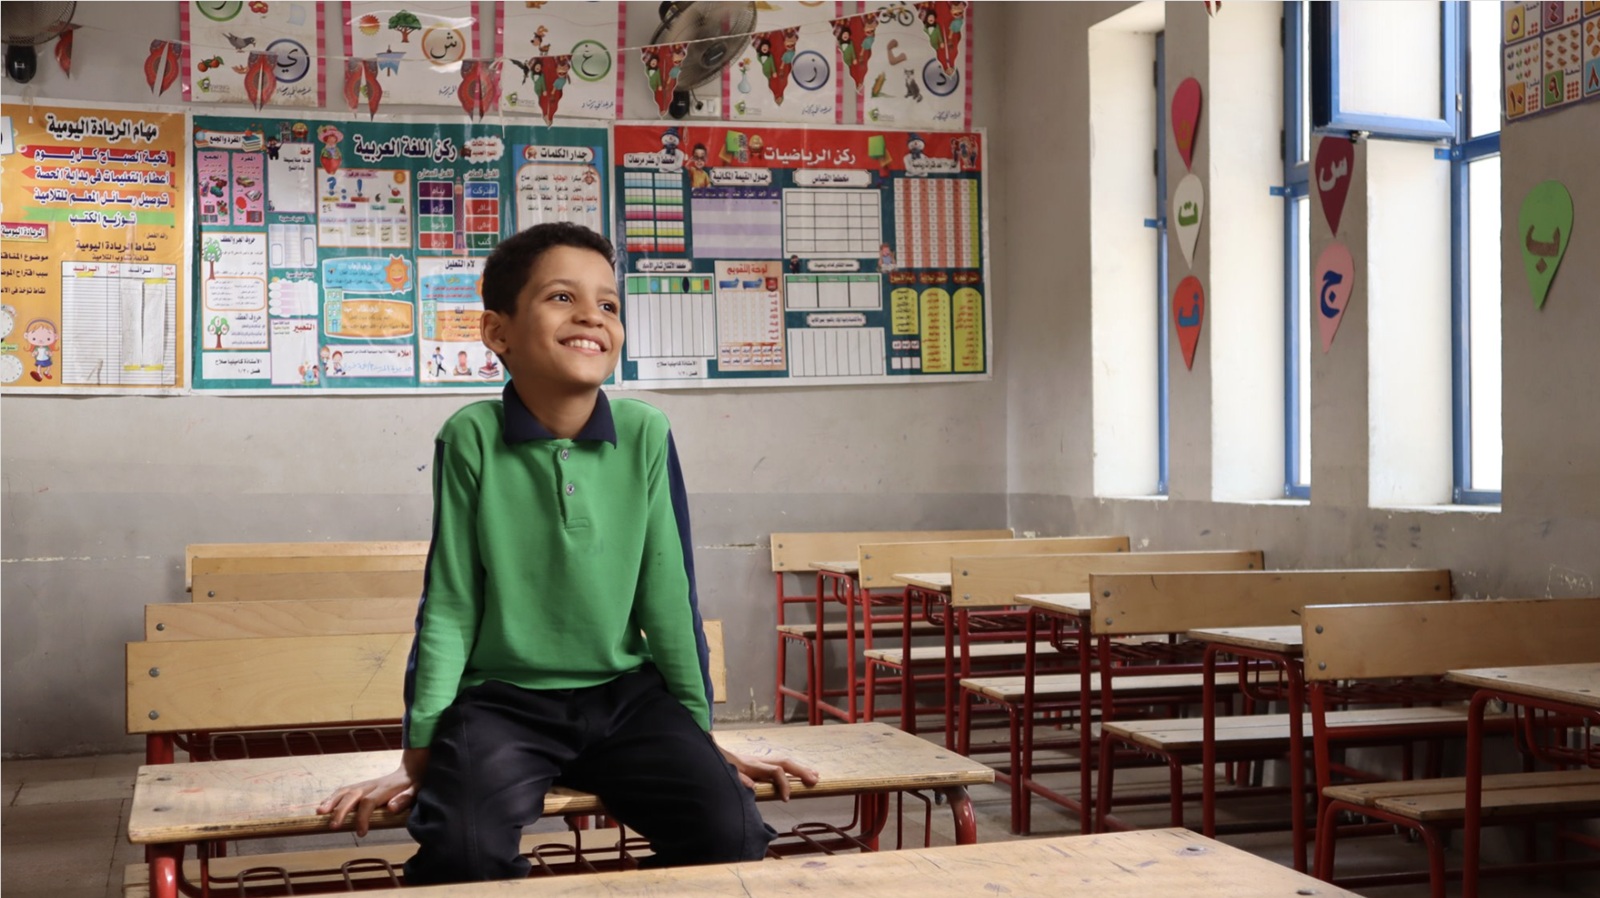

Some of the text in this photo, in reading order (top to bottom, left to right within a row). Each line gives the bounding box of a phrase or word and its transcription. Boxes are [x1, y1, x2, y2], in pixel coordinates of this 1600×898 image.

[430, 32, 457, 59] ش
[277, 49, 298, 73] ي
[804, 58, 818, 83] ز
[47, 116, 157, 142] مهام الريادة اليومية
[100, 151, 142, 165] الصباح
[144, 153, 168, 167] تحية
[354, 136, 457, 162] ركن اللغة العربية
[540, 147, 587, 161] جدار الكلمات
[764, 147, 856, 166] ركن الرياضيات
[36, 167, 63, 181] الحصة
[65, 169, 89, 186] بداية
[104, 171, 142, 187] التعليمات
[1319, 156, 1348, 191] س
[1178, 201, 1199, 227] ت
[1525, 224, 1561, 275] ب
[1320, 270, 1343, 319] ج
